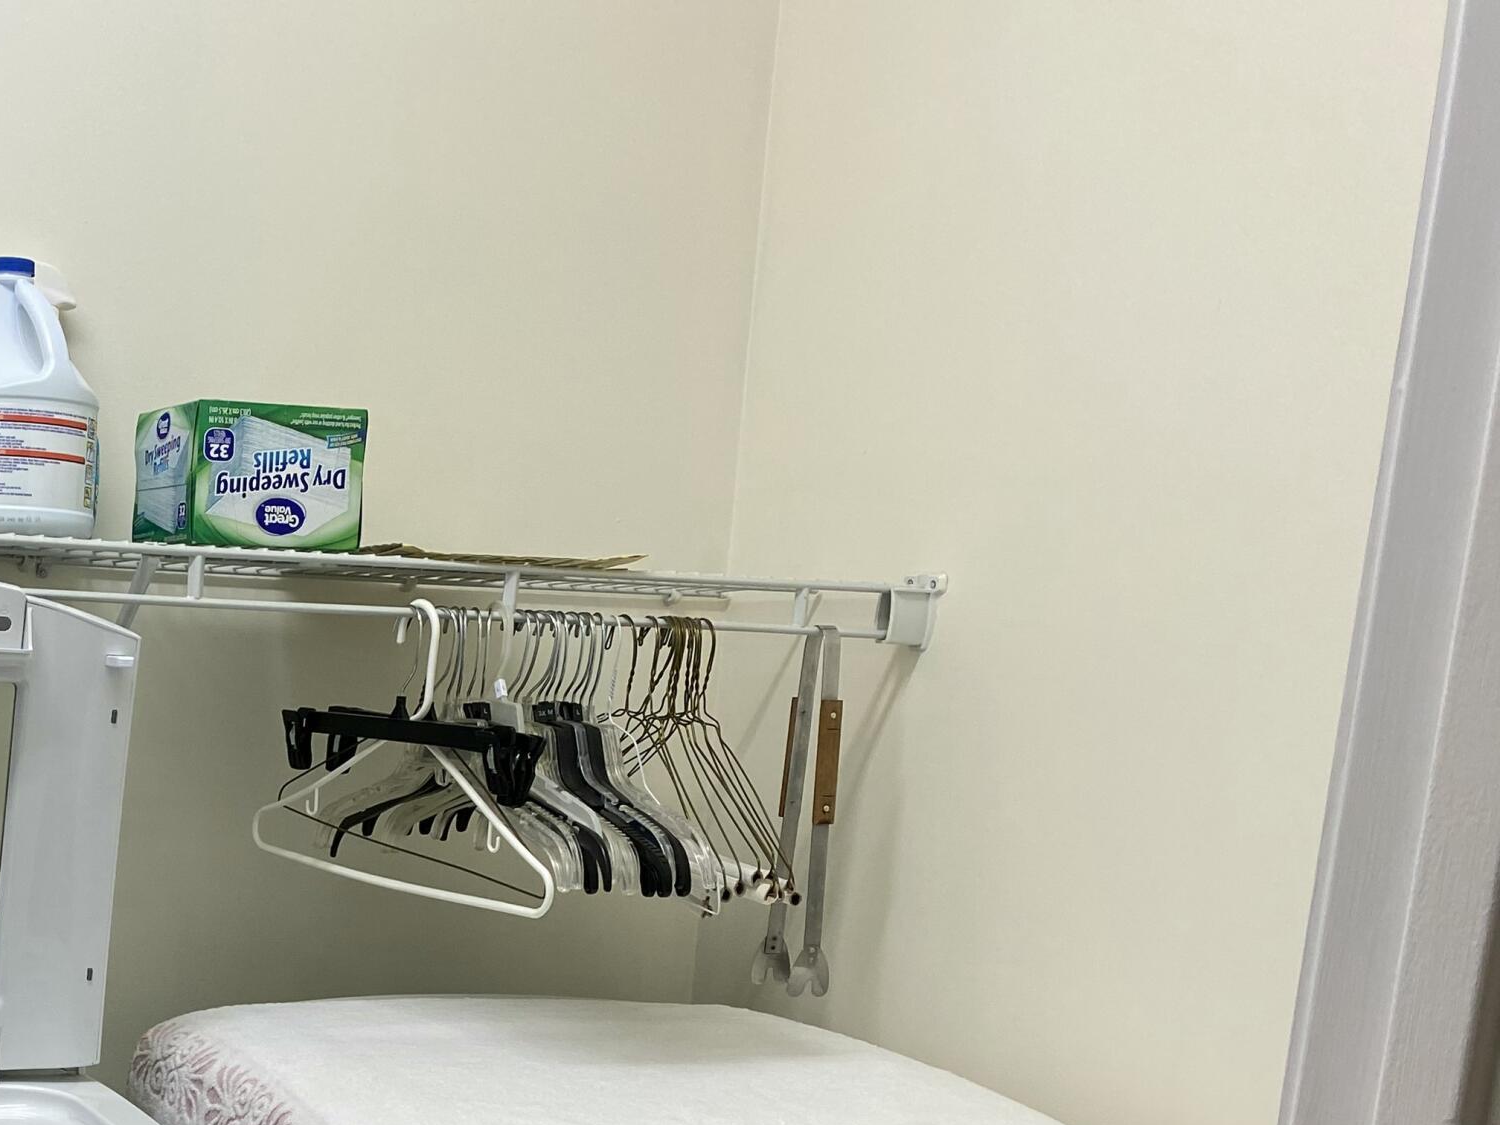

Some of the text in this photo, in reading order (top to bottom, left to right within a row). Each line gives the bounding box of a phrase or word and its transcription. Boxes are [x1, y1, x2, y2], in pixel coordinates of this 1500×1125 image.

[144, 434, 181, 468] Dry Sweeping
[209, 444, 229, 458] 32
[253, 448, 312, 472] Refills
[153, 457, 169, 476] Refills
[216, 465, 346, 498] Dry Sweeping
[264, 505, 291, 515] Value
[264, 514, 299, 527] Great
